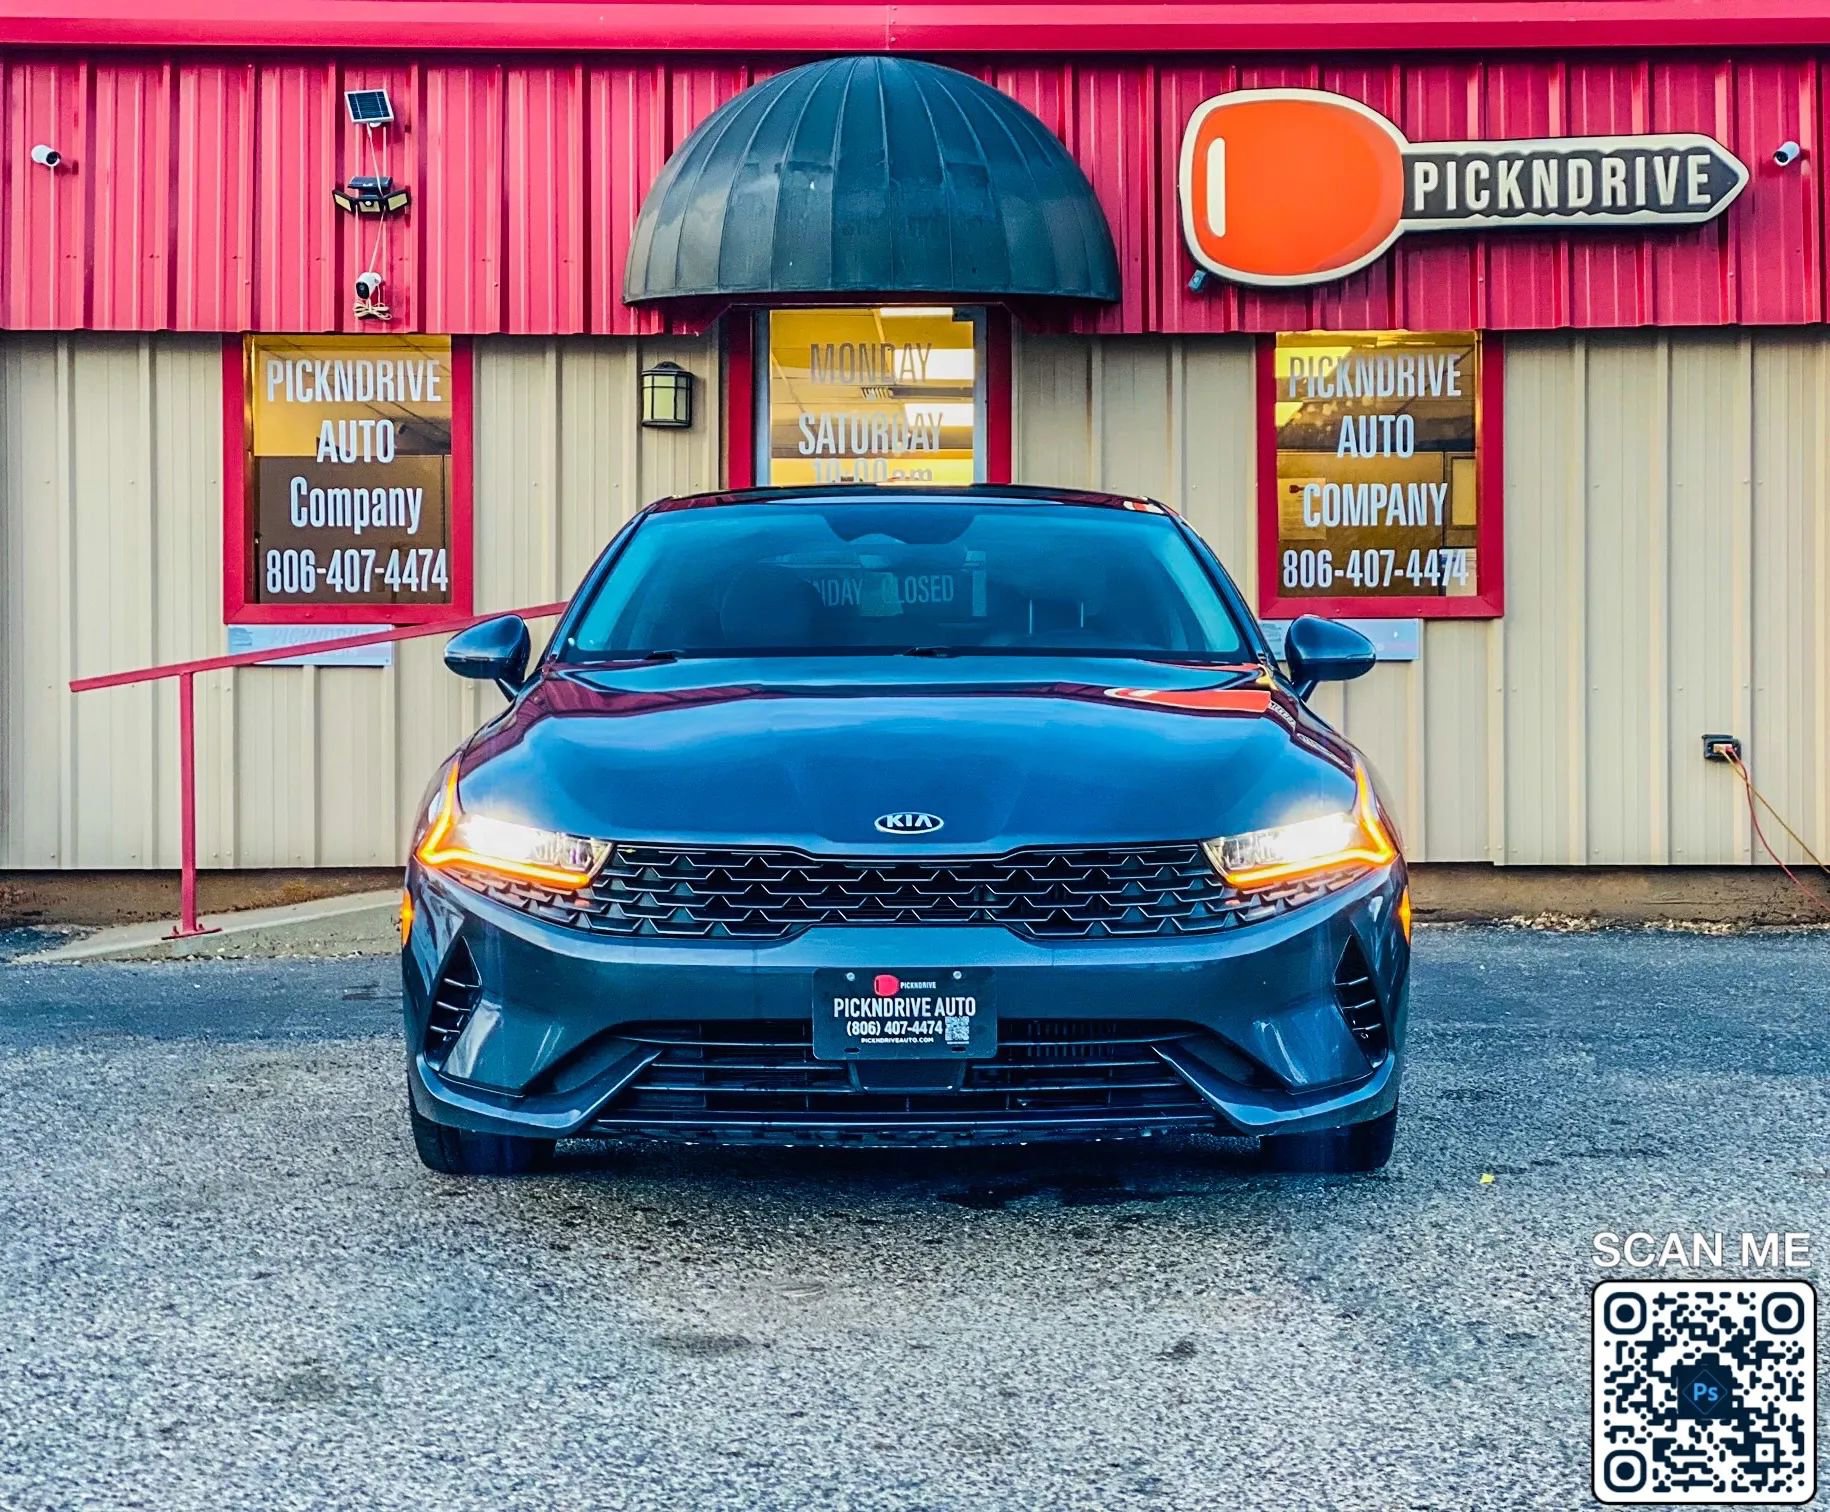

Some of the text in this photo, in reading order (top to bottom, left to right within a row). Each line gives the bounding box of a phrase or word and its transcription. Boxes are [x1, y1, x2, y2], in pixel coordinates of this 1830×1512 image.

[1413, 154, 1711, 211] PICKNDRIVE
[266, 359, 442, 402] PICKNDRIVE
[810, 343, 932, 385] MONDAY
[1288, 354, 1462, 398] PICKNDRIVE
[316, 419, 395, 463] AUTO
[798, 412, 943, 455] SATURDAY
[1336, 414, 1415, 458] AUTO
[290, 476, 423, 535] Company
[1302, 482, 1448, 528] COMPANY
[266, 548, 448, 593] 806-407-4474
[1282, 549, 1470, 588] 806-407-4474
[886, 814, 933, 828] KIA
[900, 981, 937, 989] PICKNDRIVE
[833, 996, 976, 1018] PICKNDRIVE AUTO
[846, 1020, 943, 1036] (806) 407-4474
